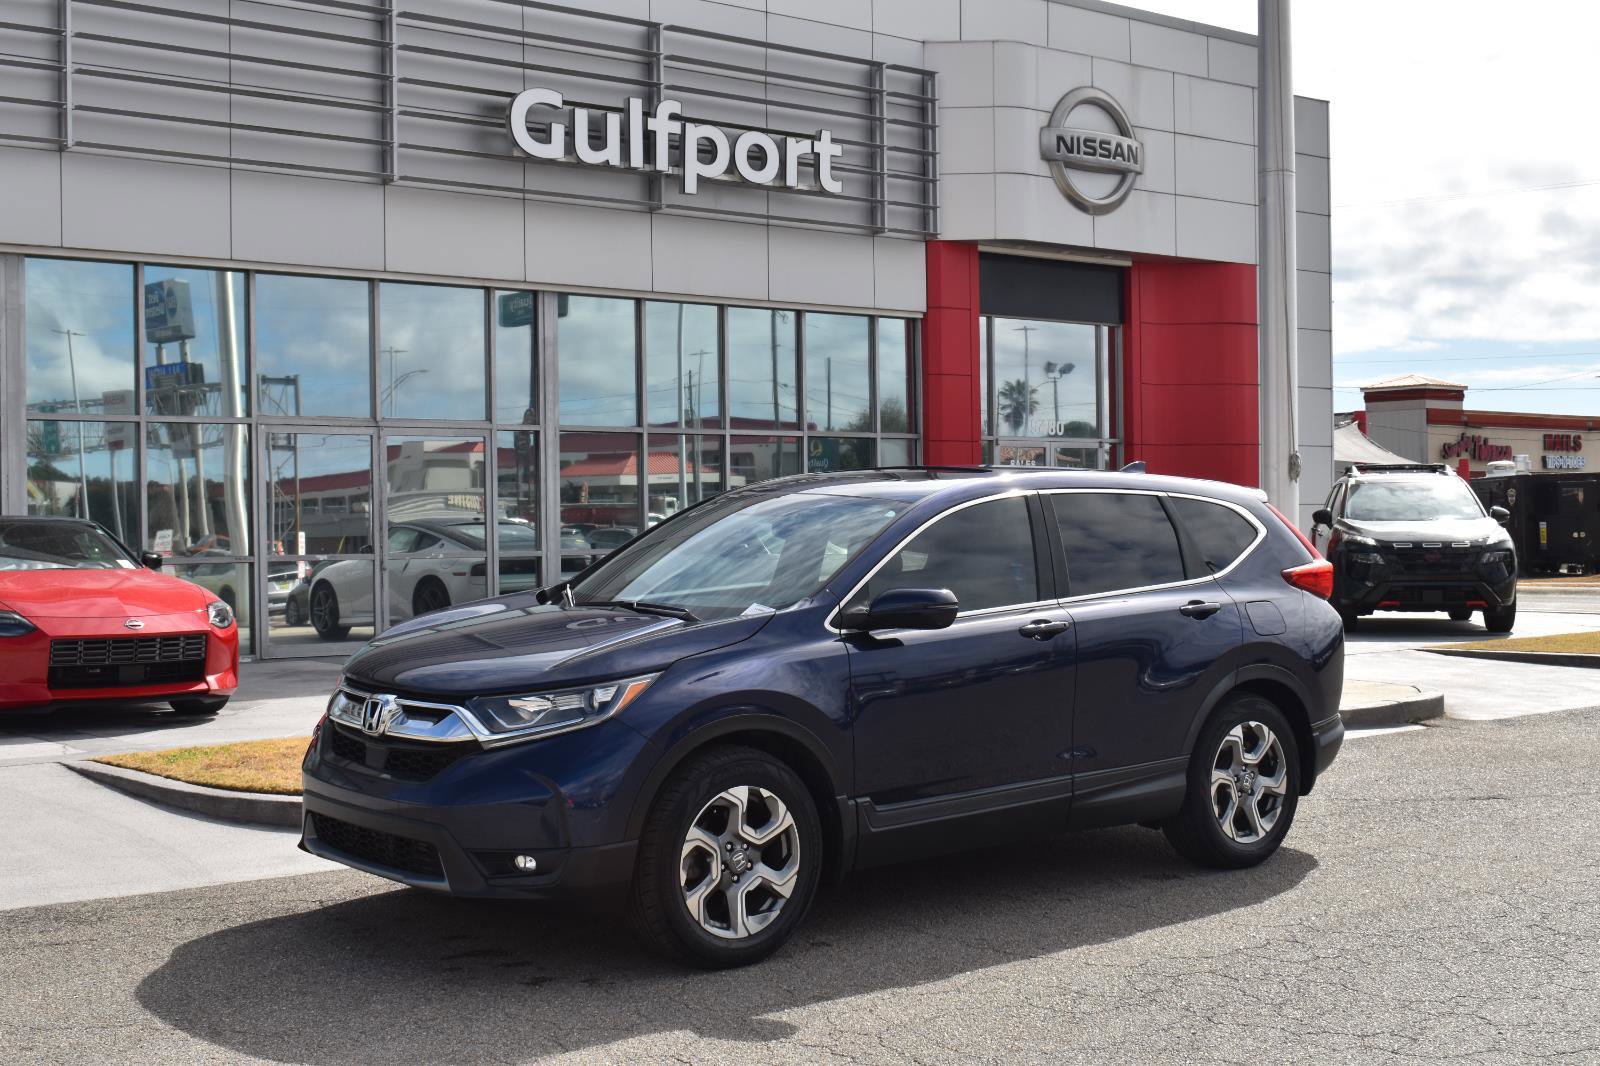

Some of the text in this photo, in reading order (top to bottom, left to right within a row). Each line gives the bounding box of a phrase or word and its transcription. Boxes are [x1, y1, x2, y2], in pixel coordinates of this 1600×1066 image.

[508, 87, 843, 194] Gulfport
[1056, 135, 1139, 165] NISSAN
[1543, 433, 1583, 452] NAILS
